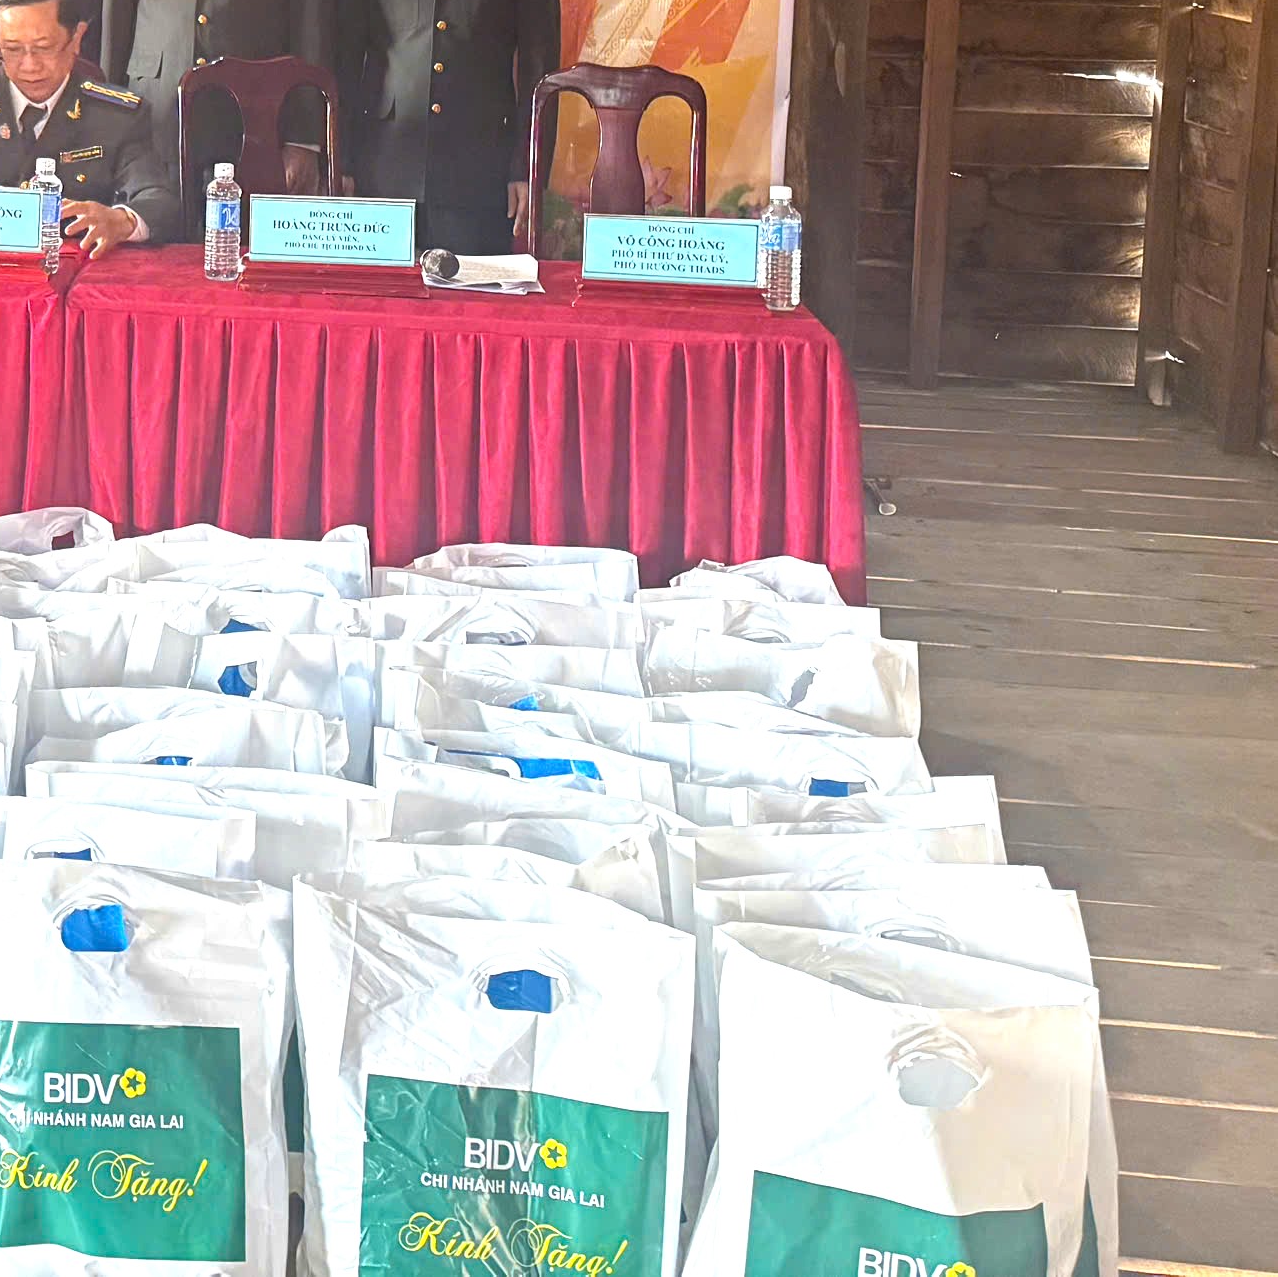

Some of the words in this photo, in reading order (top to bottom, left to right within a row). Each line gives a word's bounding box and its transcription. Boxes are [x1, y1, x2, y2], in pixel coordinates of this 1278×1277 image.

[43, 1071, 121, 1105] BIDV
[33, 1108, 86, 1127] NHÁNH
[90, 1113, 125, 1128] NAM
[129, 1114, 156, 1129] GIA
[160, 1114, 184, 1130] LAI
[464, 1137, 541, 1172] BIDV
[87, 1149, 209, 1212] Tặng!
[420, 1172, 448, 1189] CHI
[452, 1173, 507, 1195] NHÁNH
[510, 1180, 544, 1198] NAM
[548, 1186, 577, 1203] GIA
[579, 1190, 605, 1209] LAI
[398, 1211, 500, 1261] Kính
